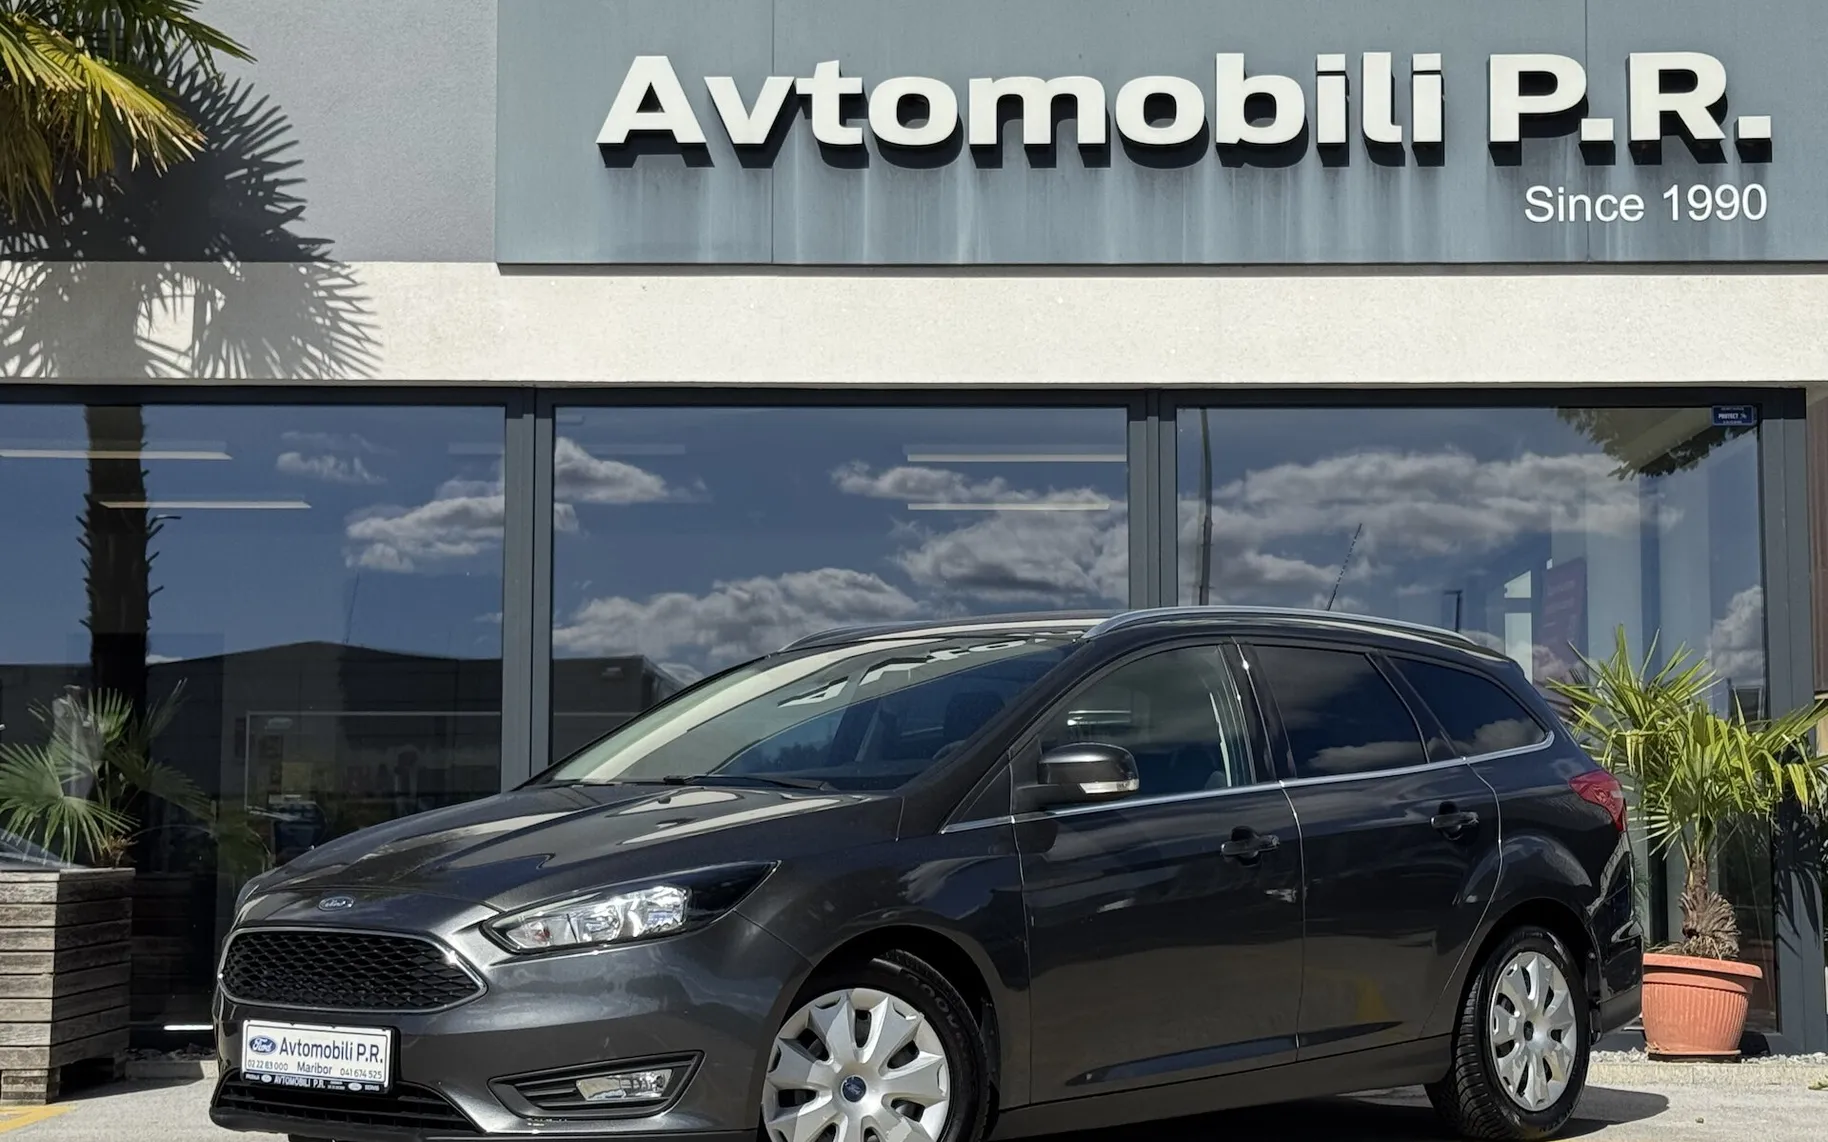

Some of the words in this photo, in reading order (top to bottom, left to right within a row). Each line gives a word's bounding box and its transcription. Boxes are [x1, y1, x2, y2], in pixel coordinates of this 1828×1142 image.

[596, 52, 1442, 145] Avtomobili
[1488, 52, 1772, 143] P.R.
[1524, 185, 1645, 223] Since
[1663, 183, 1768, 222] 1990
[251, 1037, 275, 1052] Ford
[279, 1036, 353, 1061] Avtomobili
[356, 1043, 383, 1063] P.R.
[297, 1061, 332, 1075] Maribor
[340, 1067, 352, 1076] 041
[368, 1070, 382, 1080] 525
[274, 1074, 310, 1088] AVTOMOBILI
